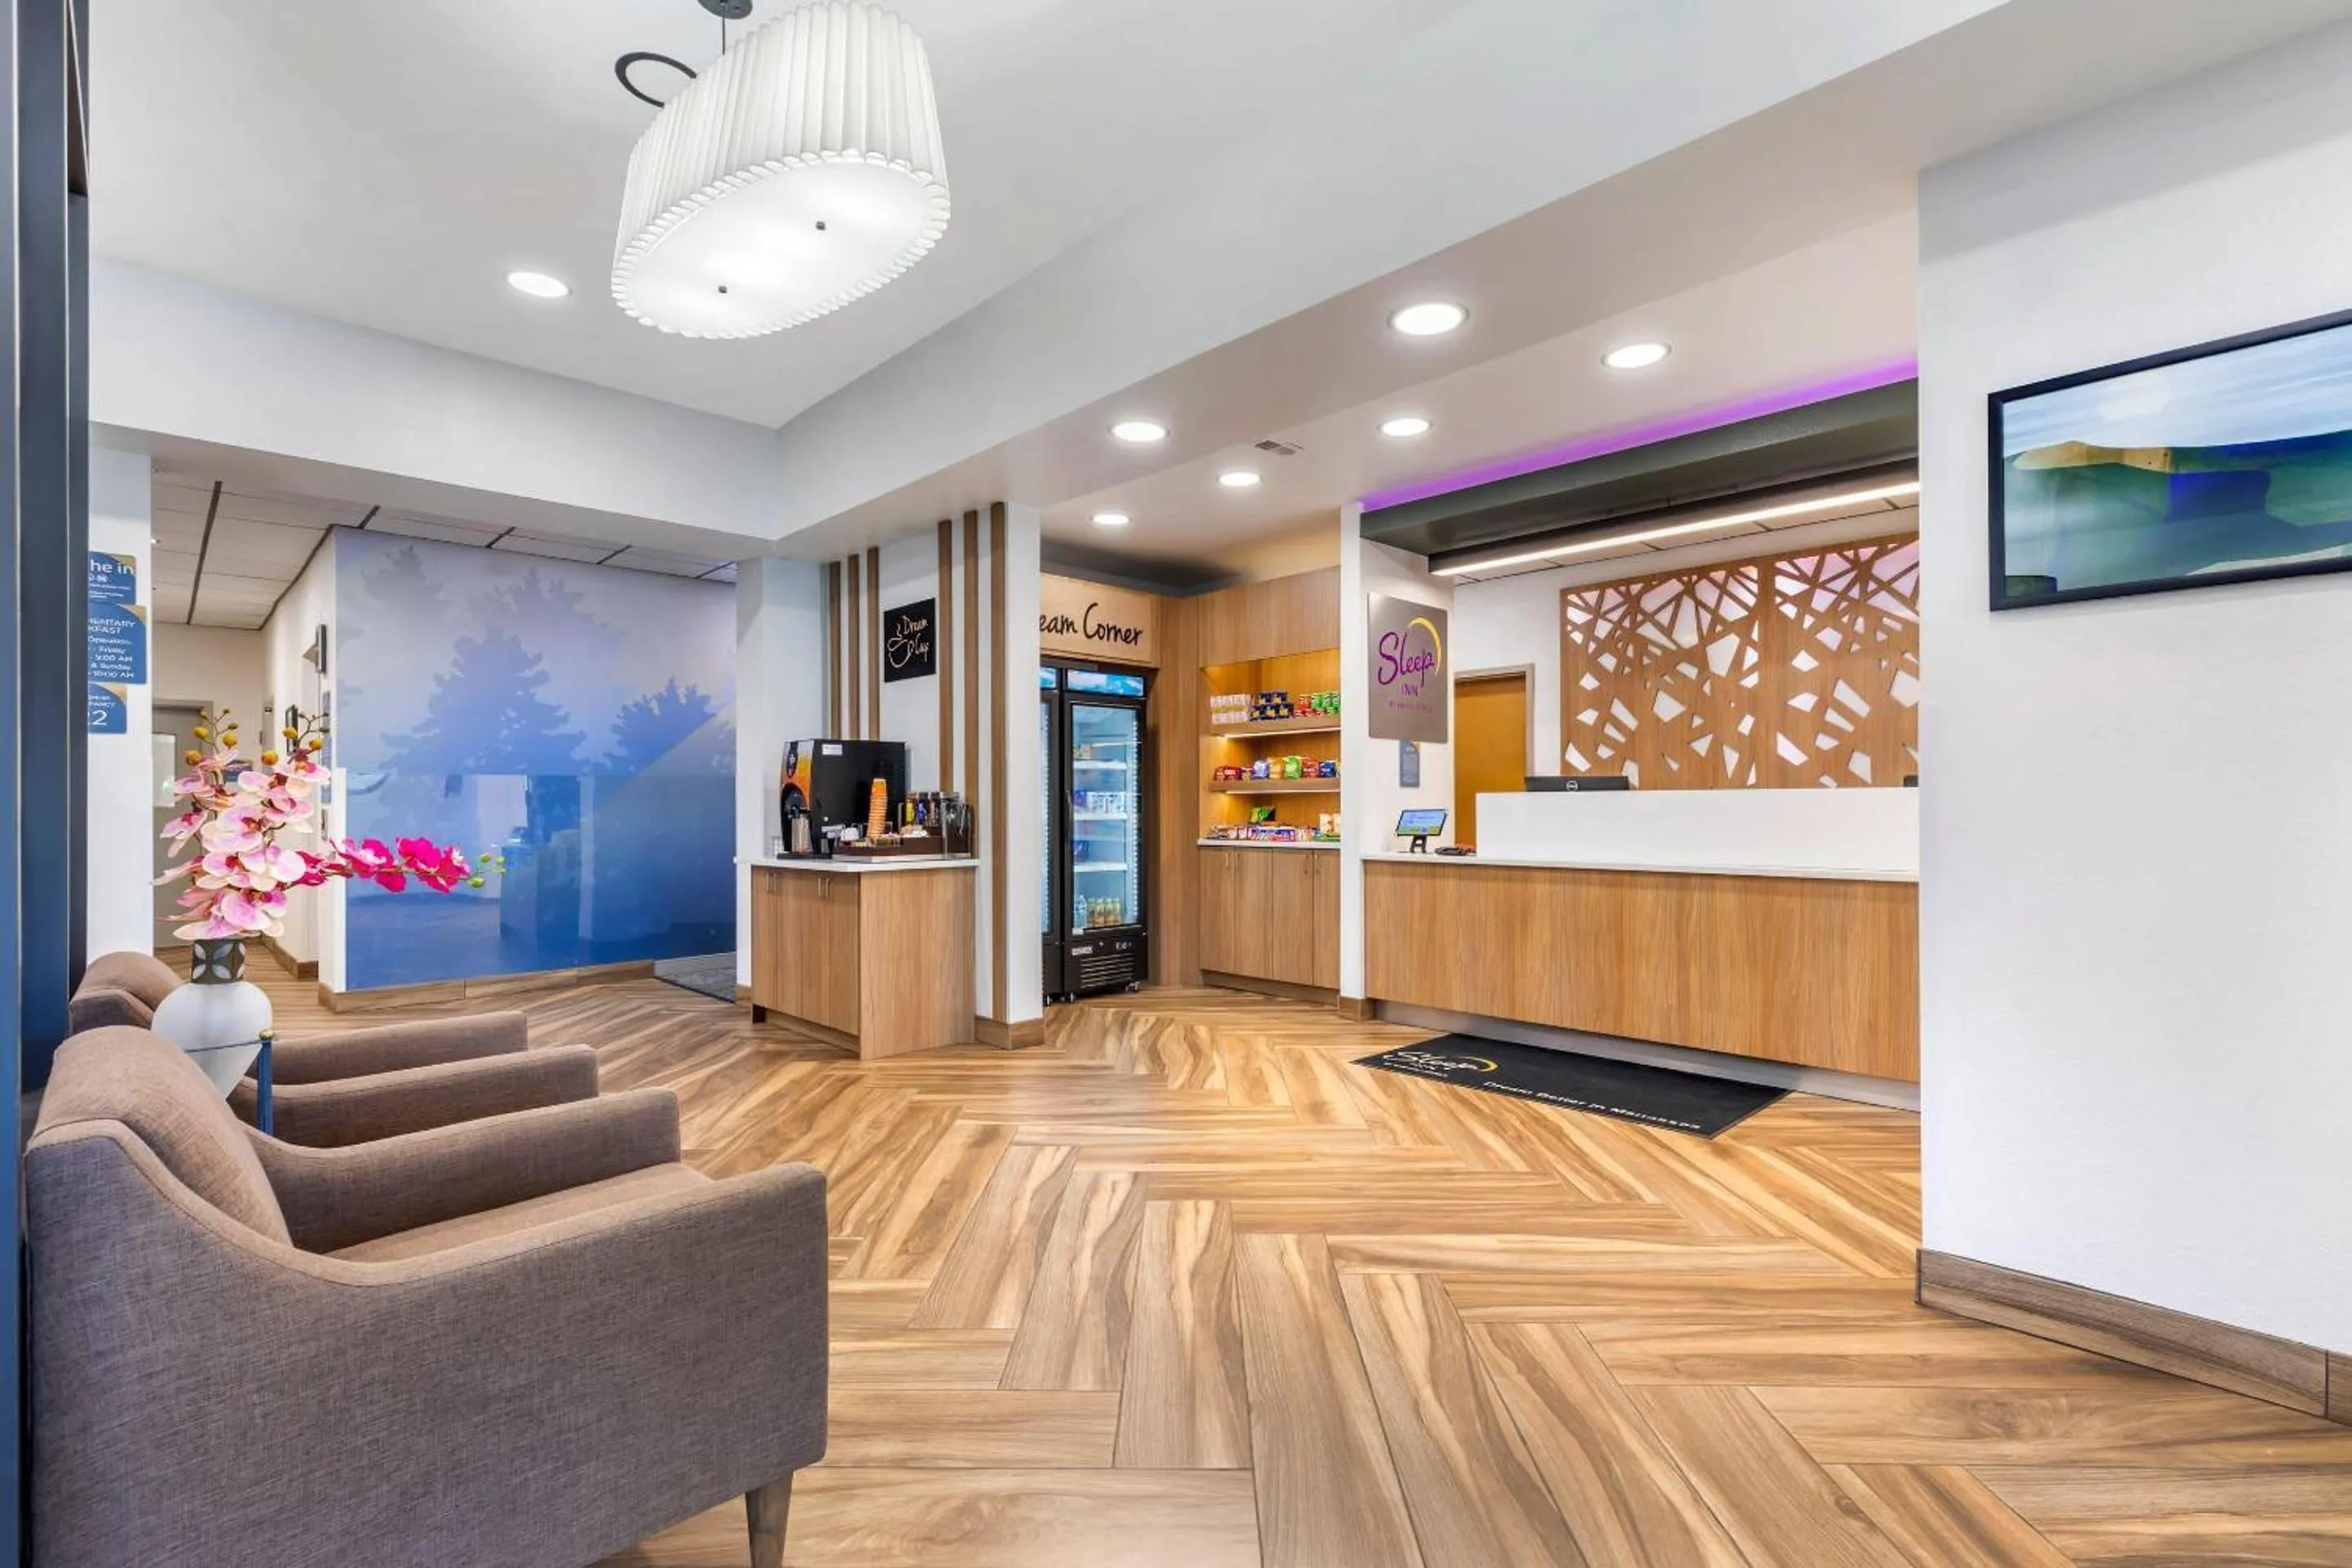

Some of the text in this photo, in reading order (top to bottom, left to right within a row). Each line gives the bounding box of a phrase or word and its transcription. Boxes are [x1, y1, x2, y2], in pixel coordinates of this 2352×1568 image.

[89, 559, 112, 573] he
[1040, 601, 1143, 645] eam Corner
[1378, 631, 1435, 687] Sleep
[1401, 683, 1419, 697] INN
[87, 709, 107, 725] 2
